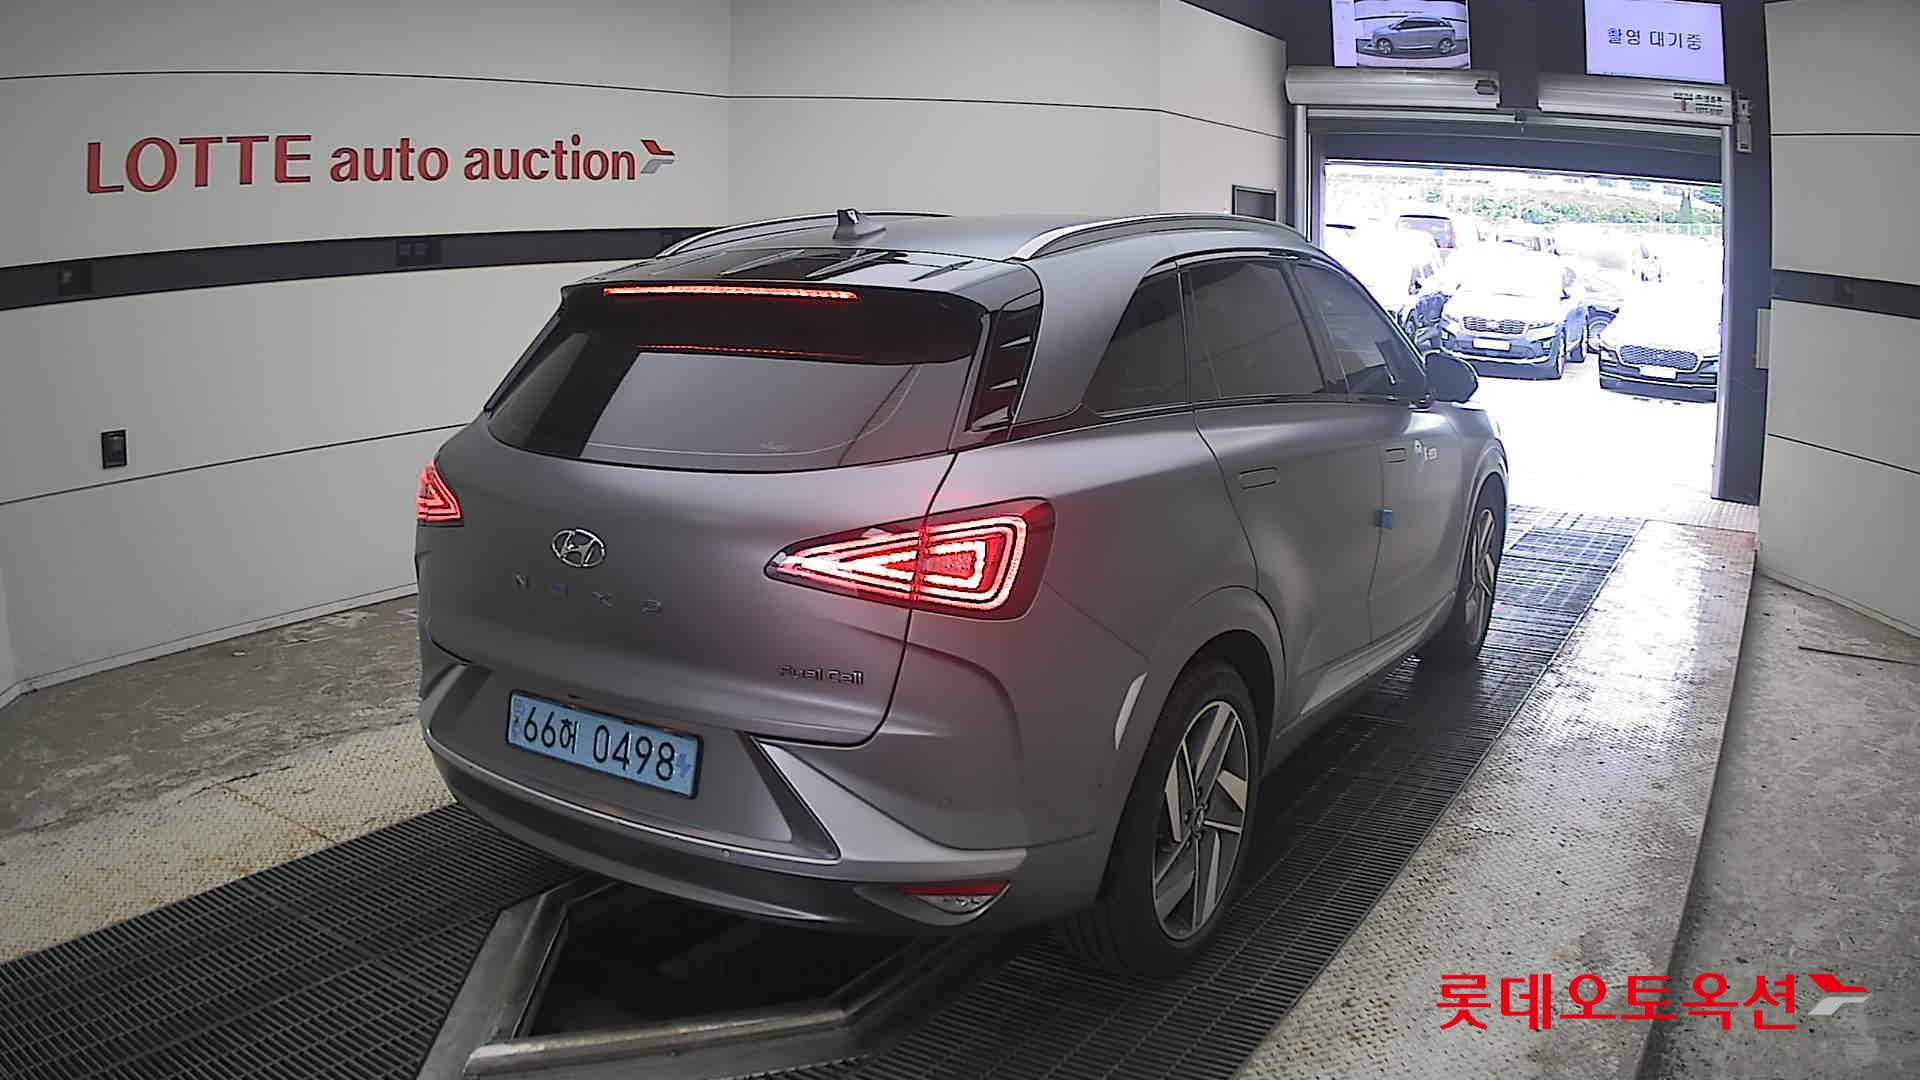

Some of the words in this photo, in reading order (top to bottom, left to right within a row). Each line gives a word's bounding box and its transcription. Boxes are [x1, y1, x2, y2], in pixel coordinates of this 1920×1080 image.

[1649, 31, 1702, 50] 대기중
[86, 134, 312, 194] LOTTE
[329, 137, 449, 182] auto
[463, 134, 636, 182] auction
[523, 706, 578, 755] 66허
[592, 724, 676, 782] 0498
